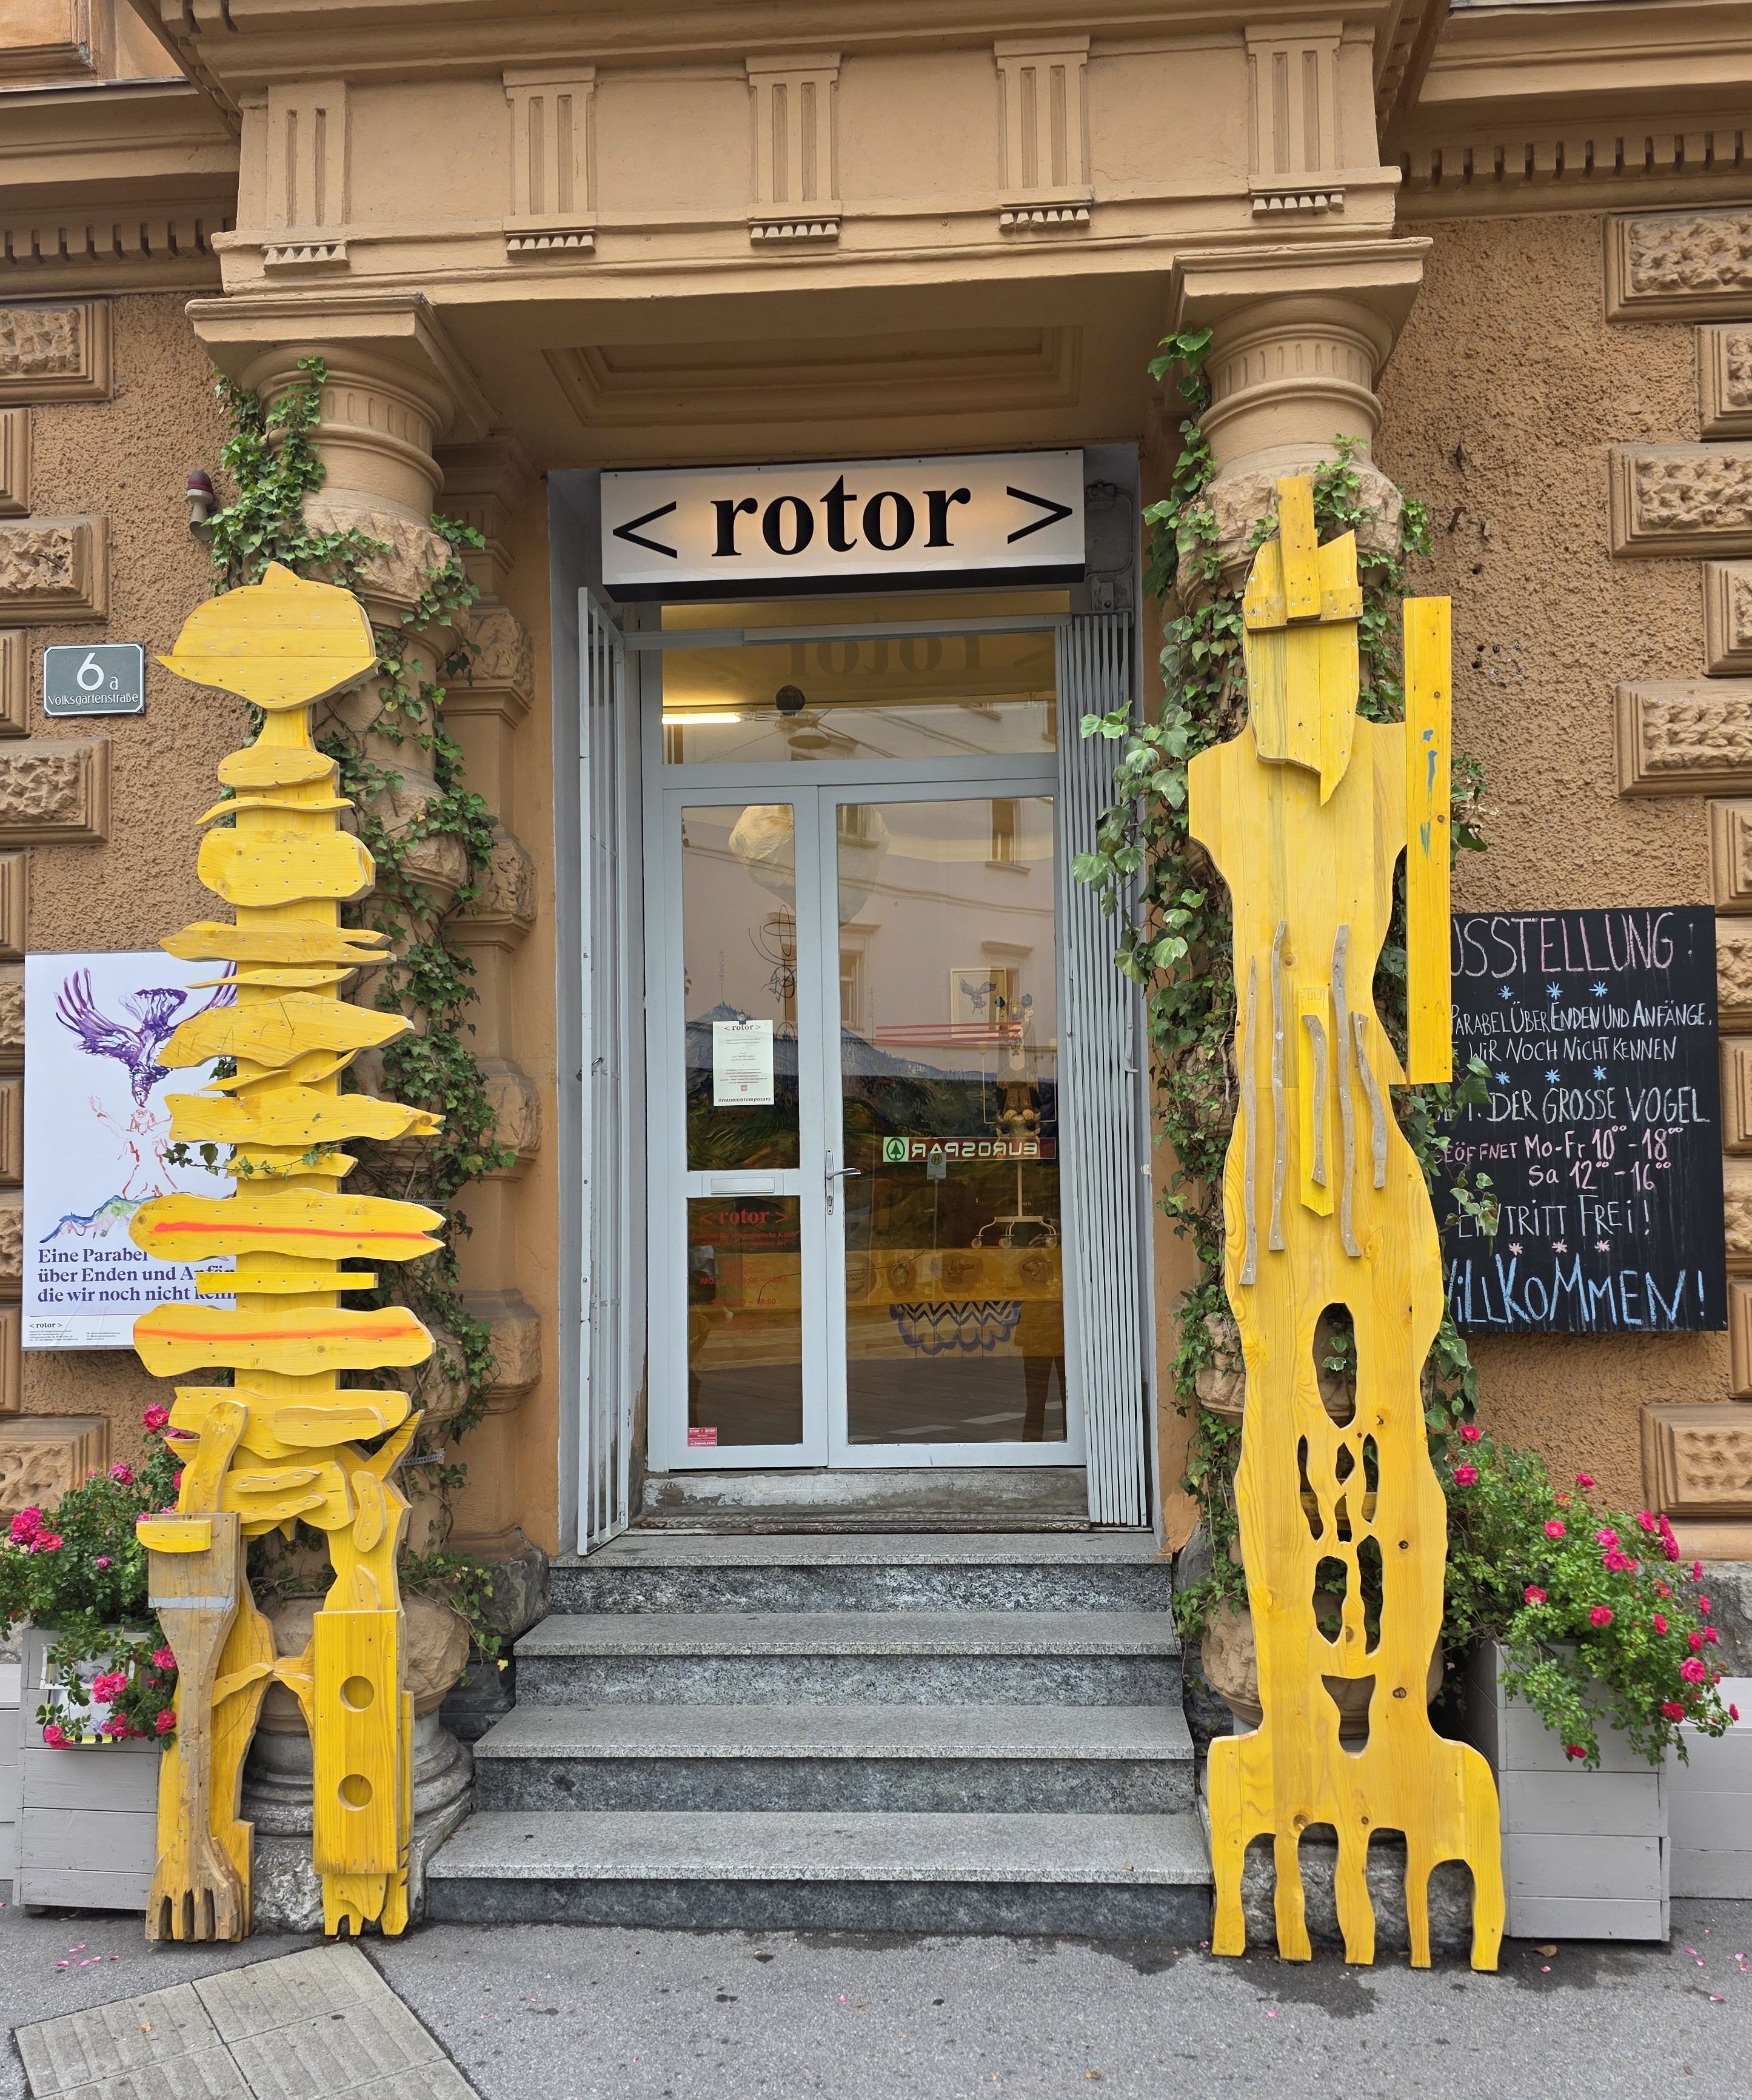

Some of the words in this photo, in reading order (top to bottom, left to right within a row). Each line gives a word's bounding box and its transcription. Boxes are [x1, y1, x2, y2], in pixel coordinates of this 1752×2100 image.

[710, 474, 971, 557] rotor
[77, 652, 104, 691] 6
[109, 675, 118, 691] a
[48, 692, 138, 706] Volksgartenstraße
[1510, 1001, 1550, 1033] ÜBER
[1550, 1002, 1601, 1031] ENDEN
[1602, 1006, 1630, 1028] UND
[1506, 1037, 1557, 1063] NOCH
[1613, 1035, 1677, 1062] KENNEN
[1486, 1088, 1538, 1122] DER
[1542, 1086, 1617, 1124] GROSSE
[1625, 1086, 1711, 1123] VOGEL
[719, 1208, 770, 1225] rotor
[38, 1248, 79, 1263] Eine
[83, 1247, 149, 1262] Parabel
[38, 1268, 78, 1282] über
[81, 1267, 138, 1282] Enden
[142, 1266, 176, 1281] und
[38, 1288, 64, 1302] die
[67, 1287, 96, 1301] wir
[98, 1286, 141, 1301] noch
[145, 1285, 191, 1300] nicht
